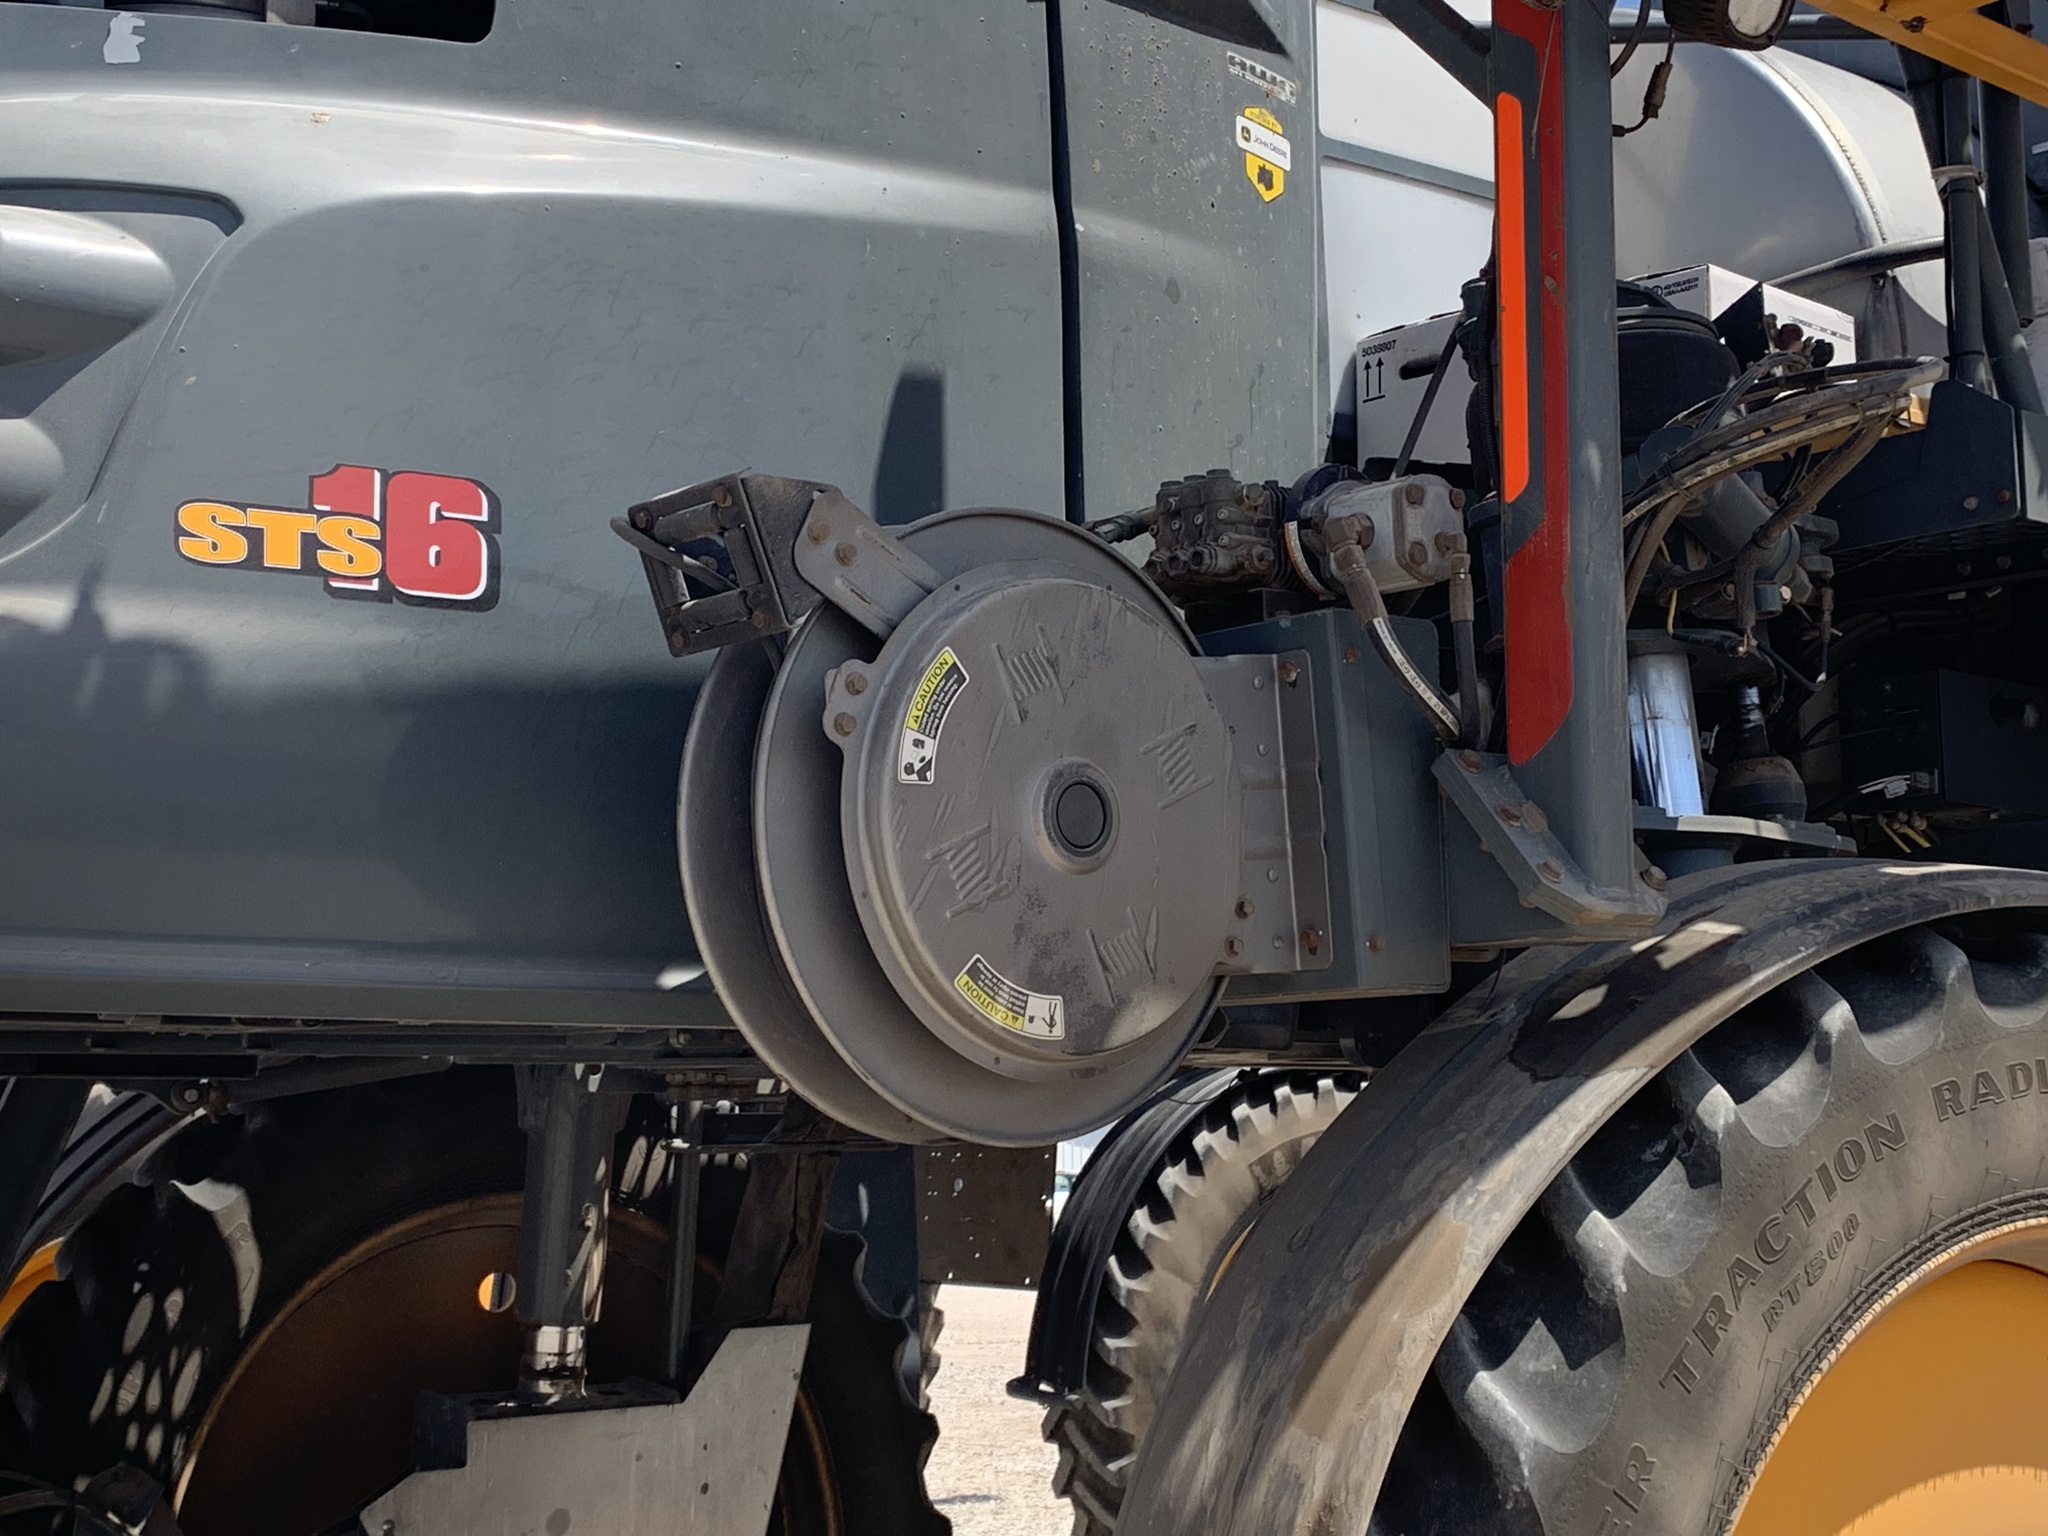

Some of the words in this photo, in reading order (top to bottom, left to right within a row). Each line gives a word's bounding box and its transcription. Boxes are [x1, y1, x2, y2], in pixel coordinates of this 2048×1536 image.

[1254, 134, 1270, 149] JOHN
[178, 502, 382, 578] STS
[312, 465, 488, 600] 16
[915, 657, 949, 712] CAUTION
[963, 980, 1009, 1021] CAUTION
[1659, 1111, 1908, 1394] TRACTION
